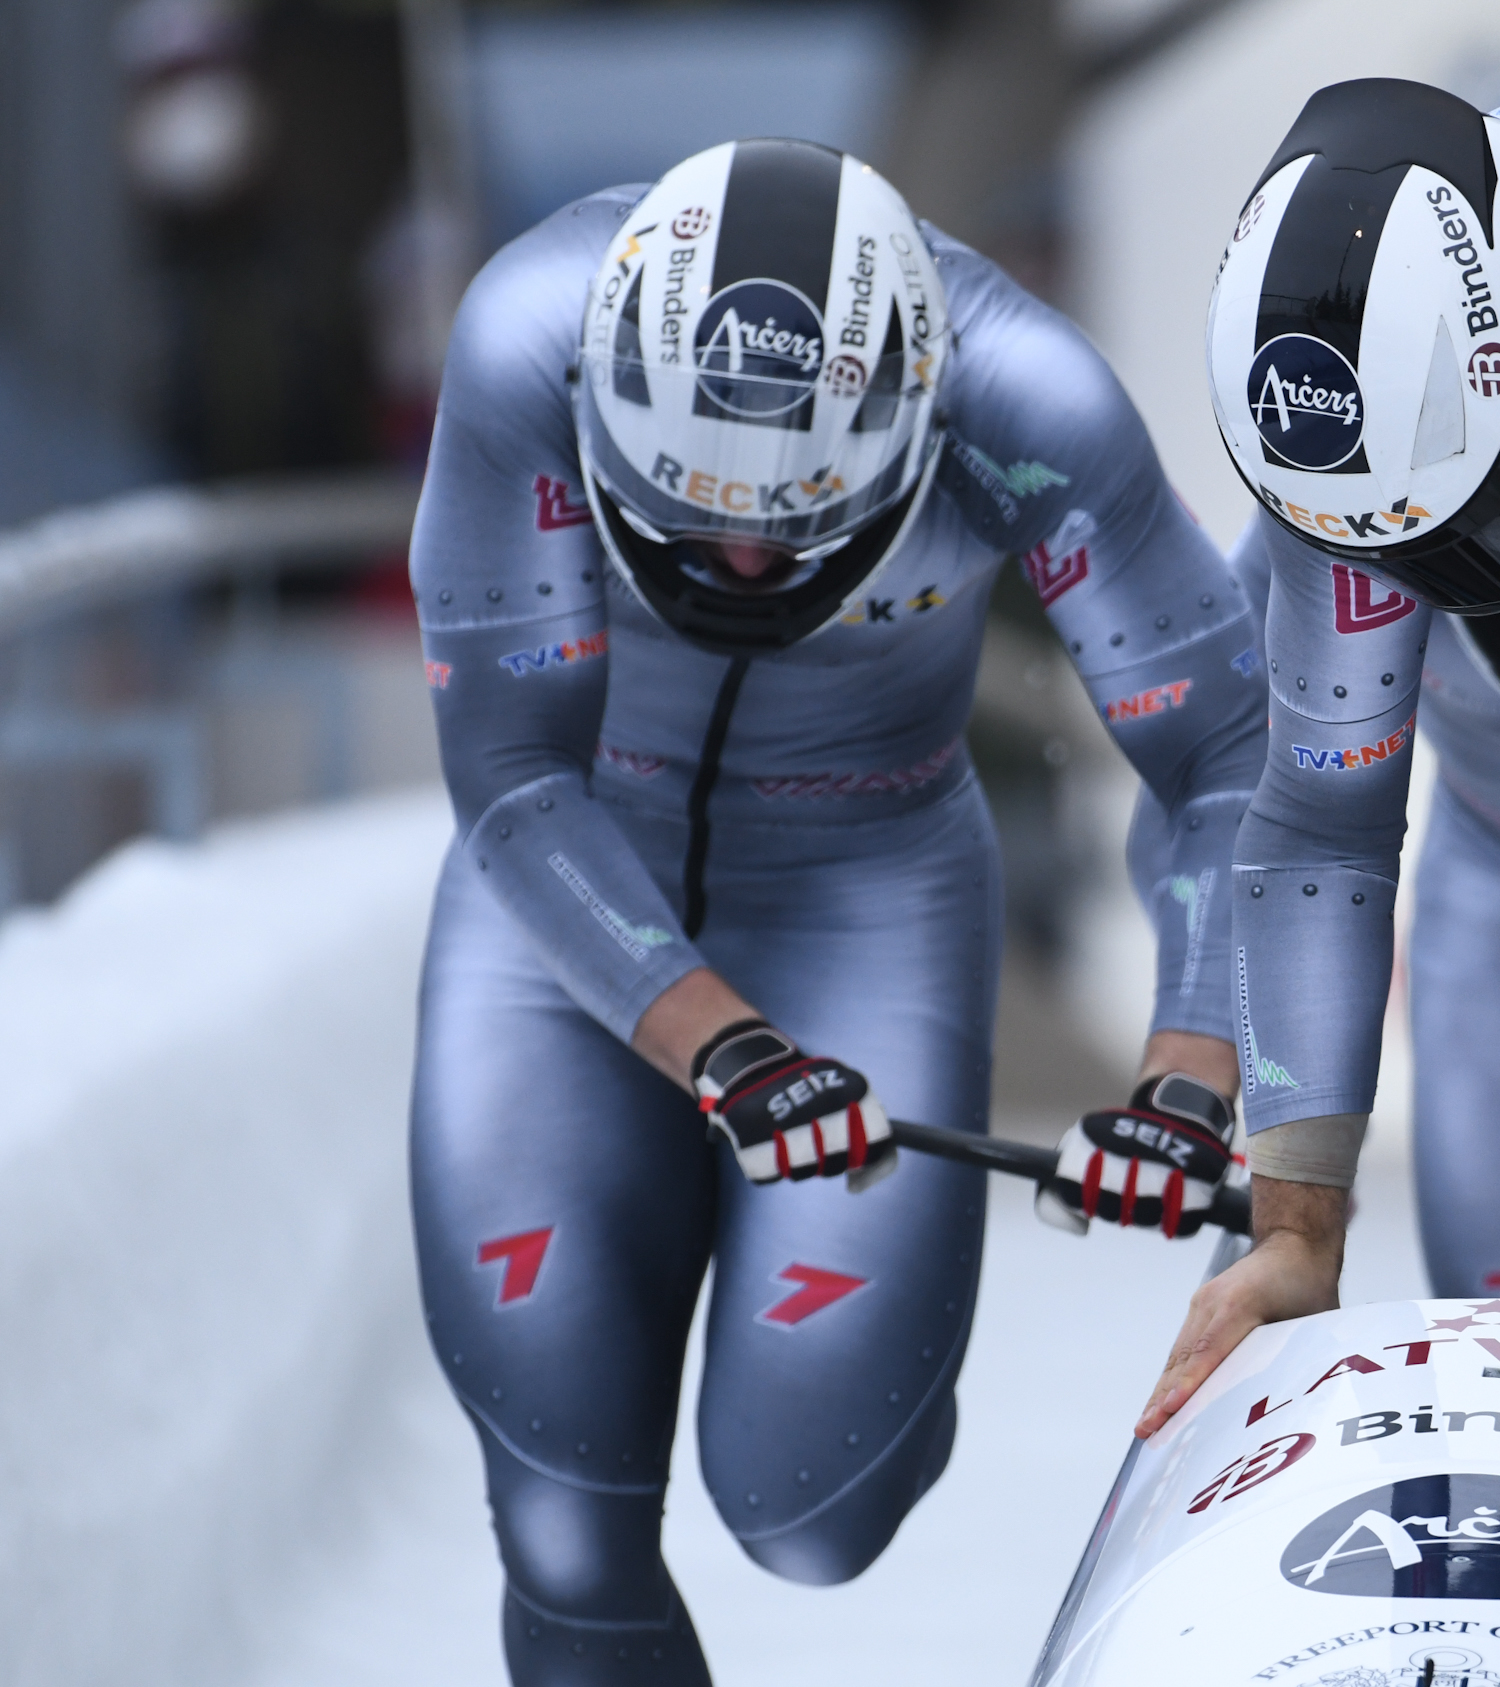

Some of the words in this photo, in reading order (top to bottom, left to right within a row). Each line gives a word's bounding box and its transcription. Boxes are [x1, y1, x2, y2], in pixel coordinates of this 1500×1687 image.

[840, 235, 876, 348] Binders
[1426, 186, 1499, 338] Binders
[660, 247, 695, 365] Binders
[1250, 364, 1364, 433] Arčers
[1238, 947, 1249, 1012] LATVIJAS
[1241, 1013, 1252, 1062] VALSTS
[767, 1068, 846, 1121] SEIZ
[1112, 1114, 1196, 1168] SEIZ
[1252, 1620, 1480, 1682] FREEPORT
